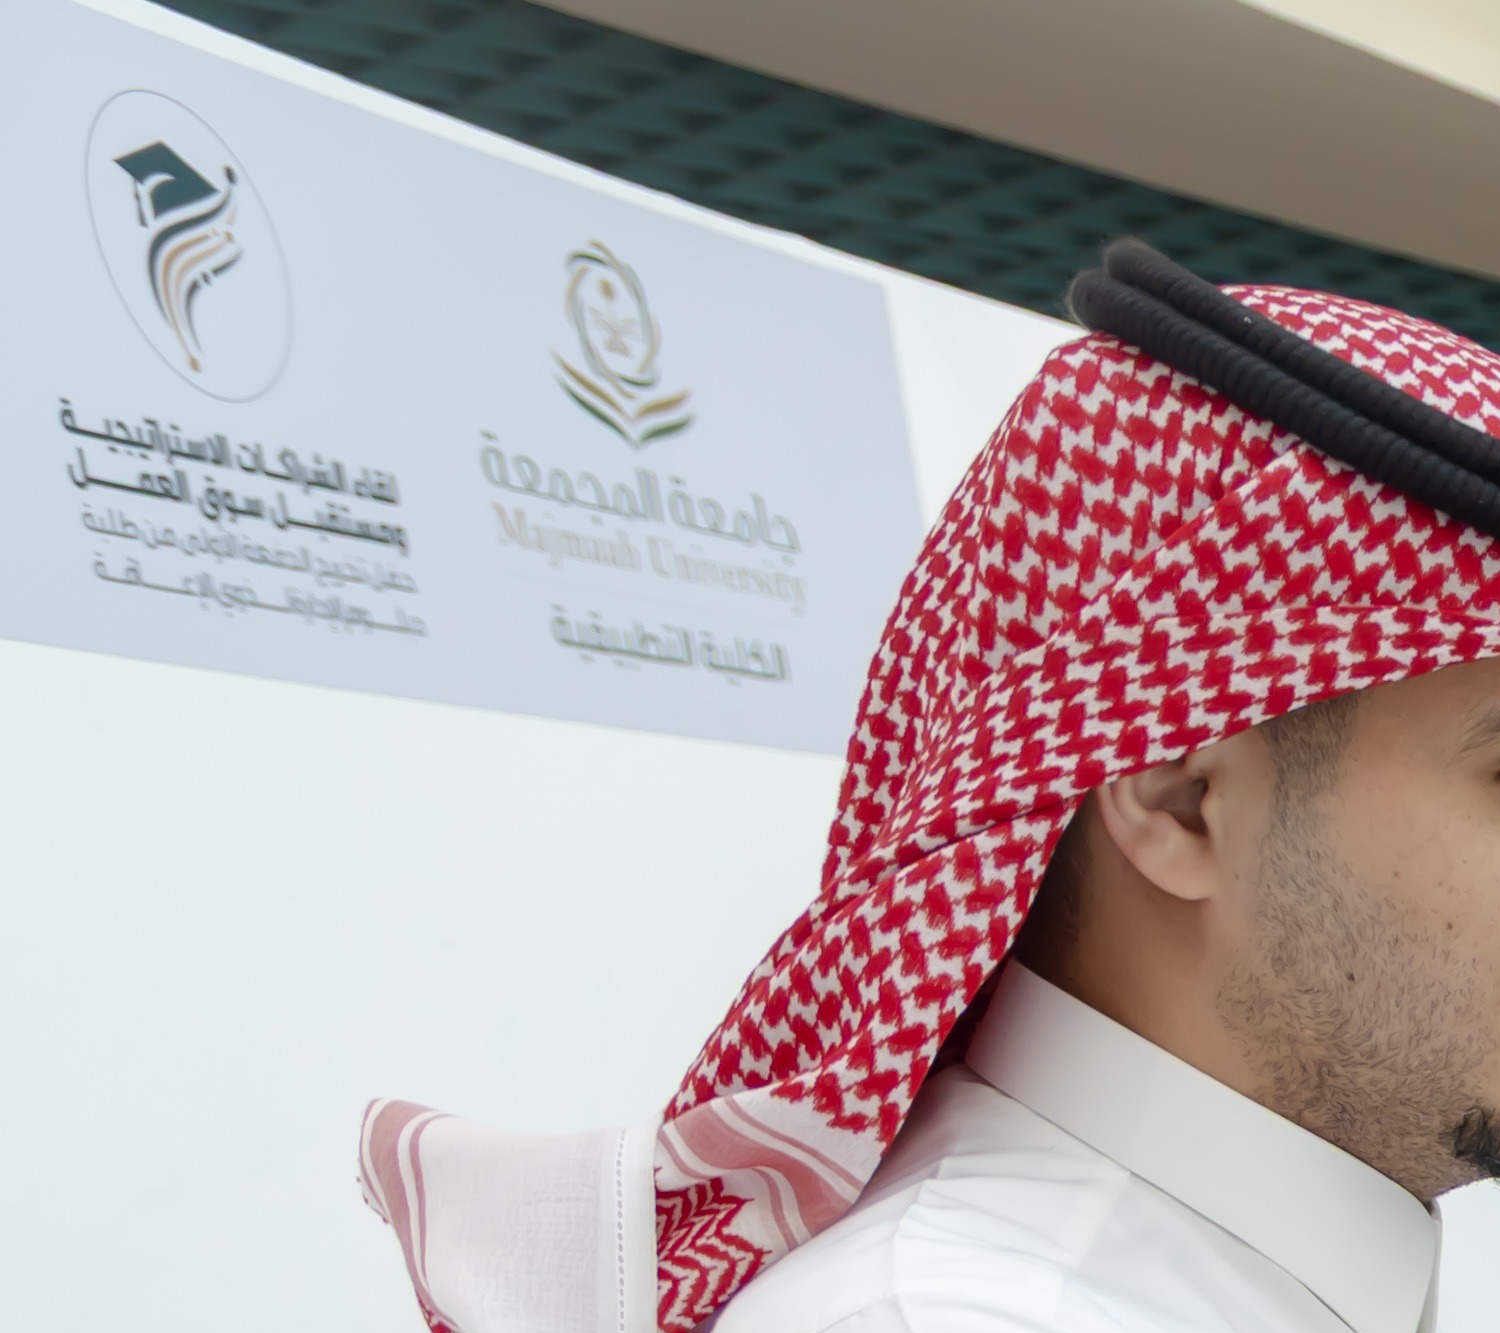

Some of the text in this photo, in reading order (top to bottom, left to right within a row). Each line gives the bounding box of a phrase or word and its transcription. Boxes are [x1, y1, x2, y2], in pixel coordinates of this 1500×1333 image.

[67, 447, 193, 503] العمل
[236, 440, 347, 496] الشركات
[197, 473, 265, 524] سوق
[480, 429, 802, 567] جامعة المجمعة
[550, 603, 791, 687] الكلية التطبيقية
